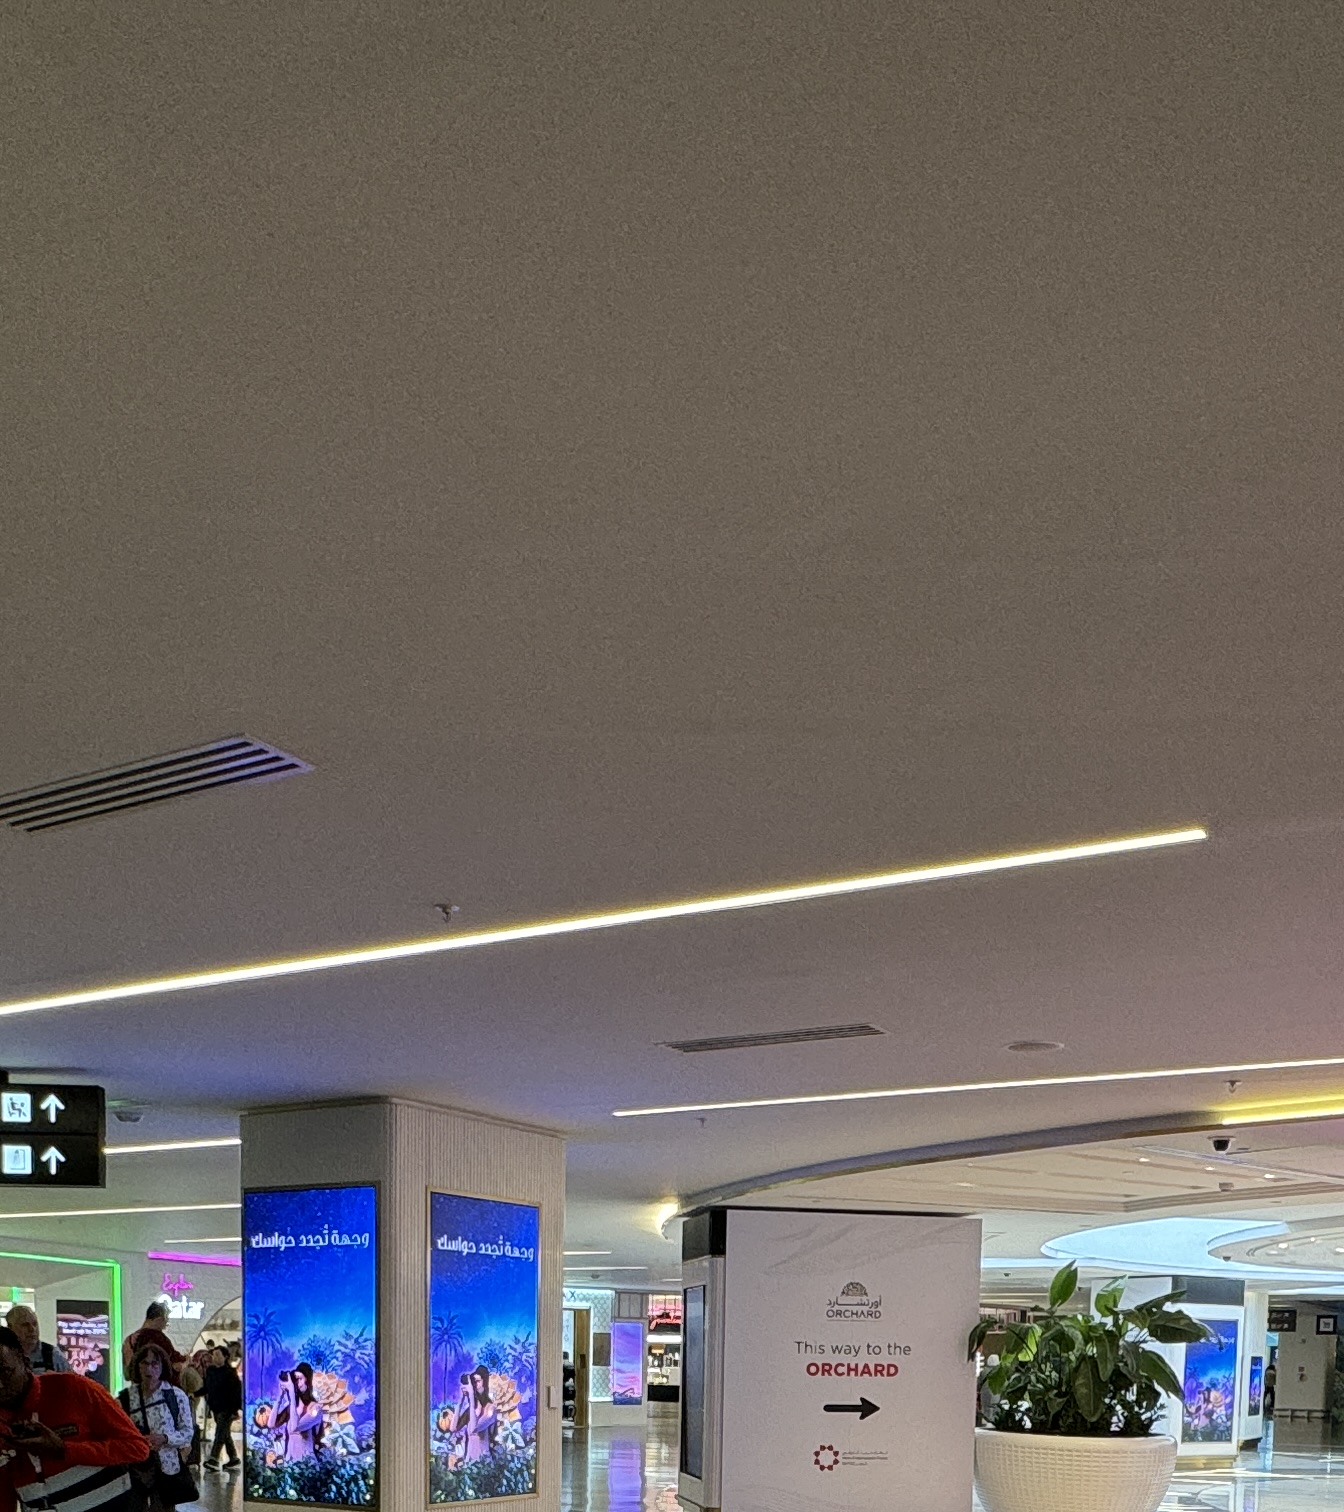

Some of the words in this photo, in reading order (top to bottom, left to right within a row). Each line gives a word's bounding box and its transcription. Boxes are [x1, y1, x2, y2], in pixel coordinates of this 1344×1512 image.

[331, 1230, 370, 1249] وجهة
[503, 1241, 535, 1263] وجهة
[826, 1309, 882, 1320] ORCHARD
[794, 1340, 826, 1355] This
[830, 1344, 862, 1358] way
[866, 1342, 882, 1356] to
[886, 1342, 912, 1356] the
[805, 1362, 899, 1377] ORCHARD
